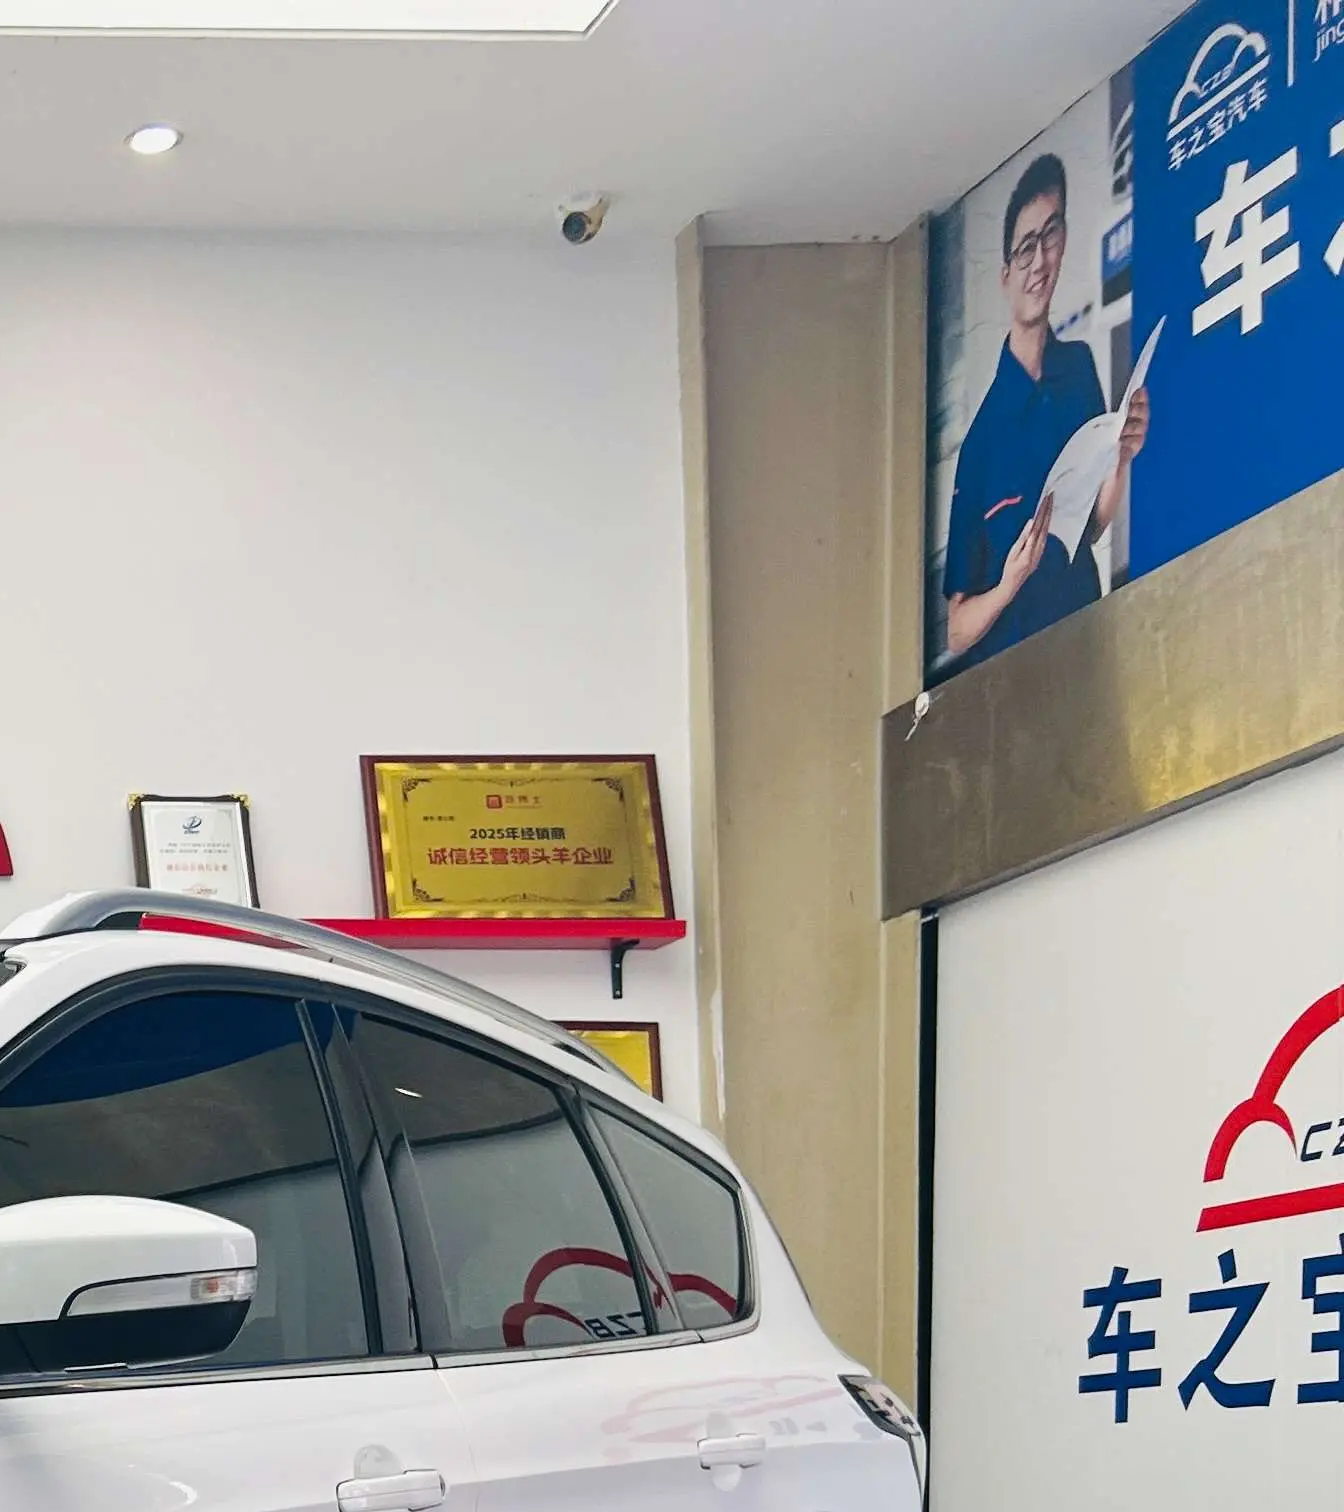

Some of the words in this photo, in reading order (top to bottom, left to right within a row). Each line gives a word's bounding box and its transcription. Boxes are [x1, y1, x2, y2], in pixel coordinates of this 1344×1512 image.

[1168, 77, 1268, 171] 车之宝汽车
[1191, 118, 1344, 336] 车
[428, 847, 613, 865] 诚信经营领头羊企业
[469, 827, 566, 841] 2025年经销商
